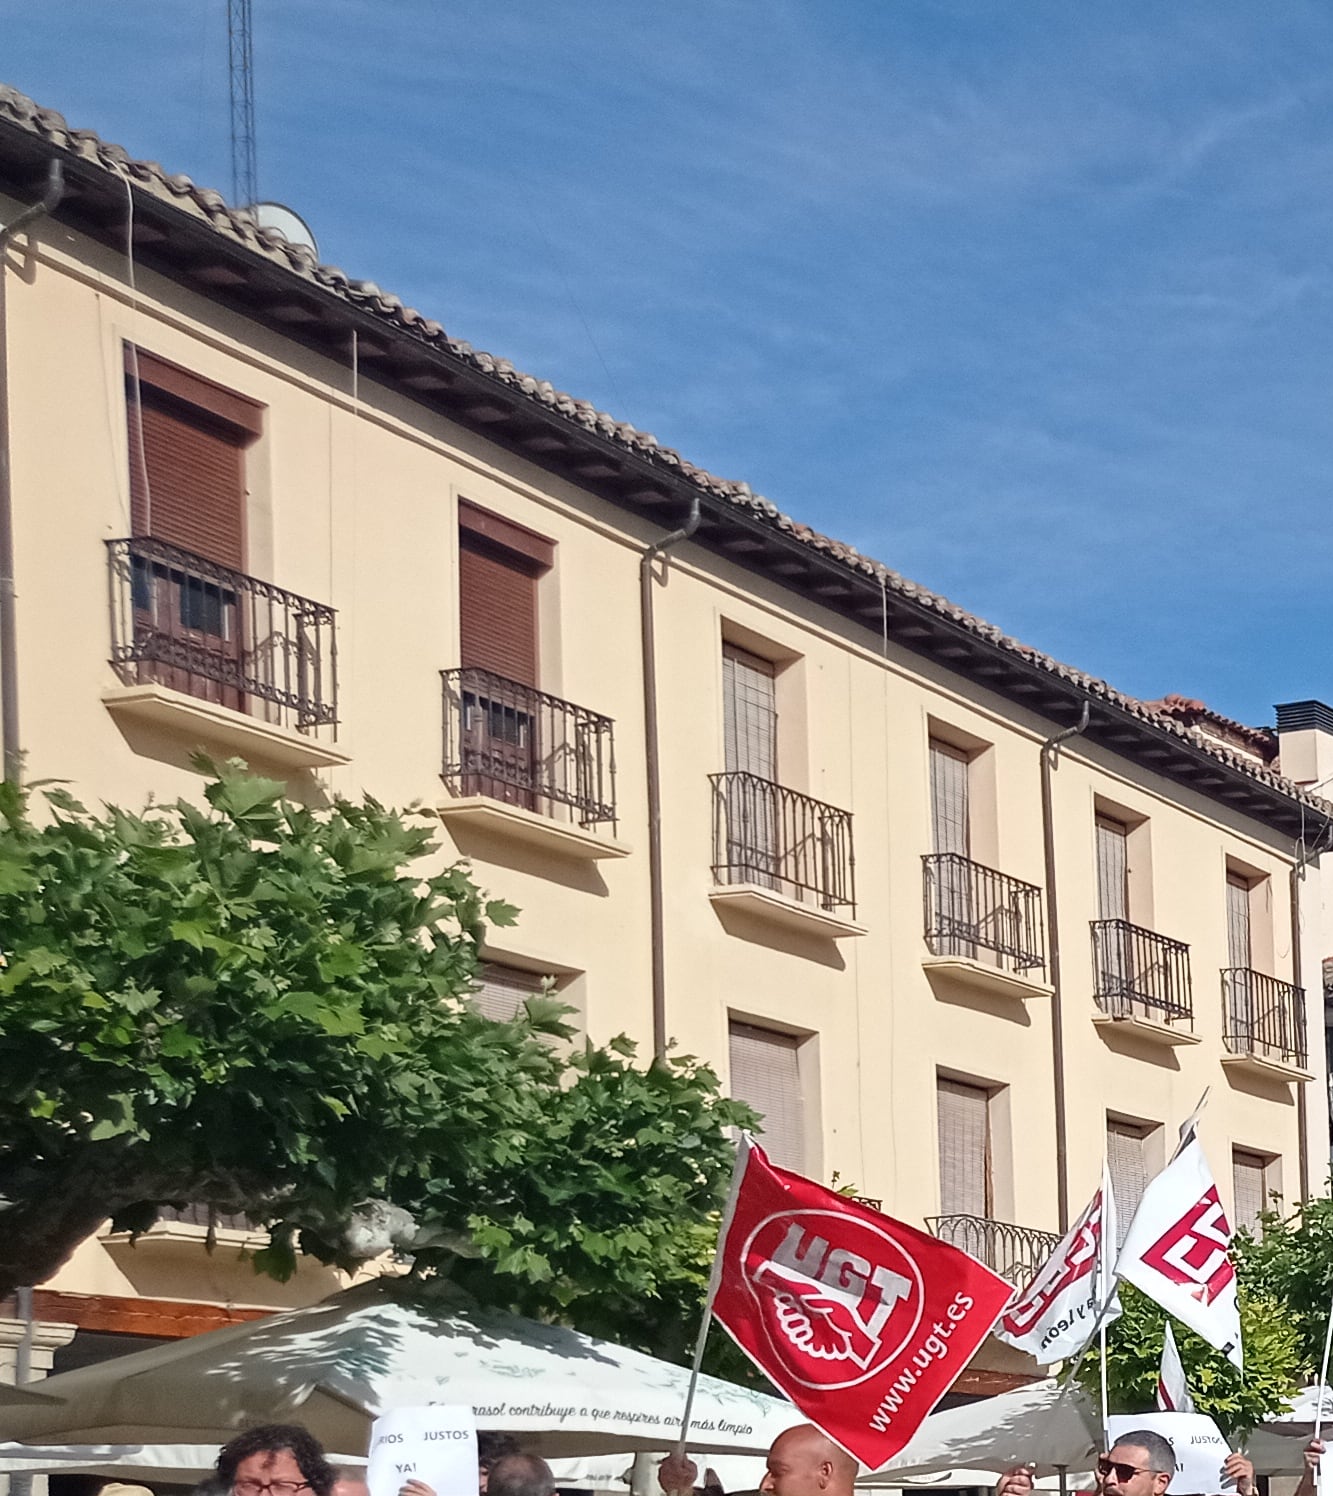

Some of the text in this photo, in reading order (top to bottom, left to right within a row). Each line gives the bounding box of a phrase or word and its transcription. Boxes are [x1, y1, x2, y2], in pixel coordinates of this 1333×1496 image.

[769, 1222, 912, 1344] UGT
[868, 1290, 975, 1433] www.ugt.es
[423, 1430, 470, 1441] JUSTOS
[509, 1402, 576, 1423] contribuye
[580, 1407, 588, 1417] a
[591, 1407, 611, 1420] que
[613, 1410, 661, 1425] respires
[718, 1418, 753, 1436] limpio
[395, 1462, 417, 1473] YA!
